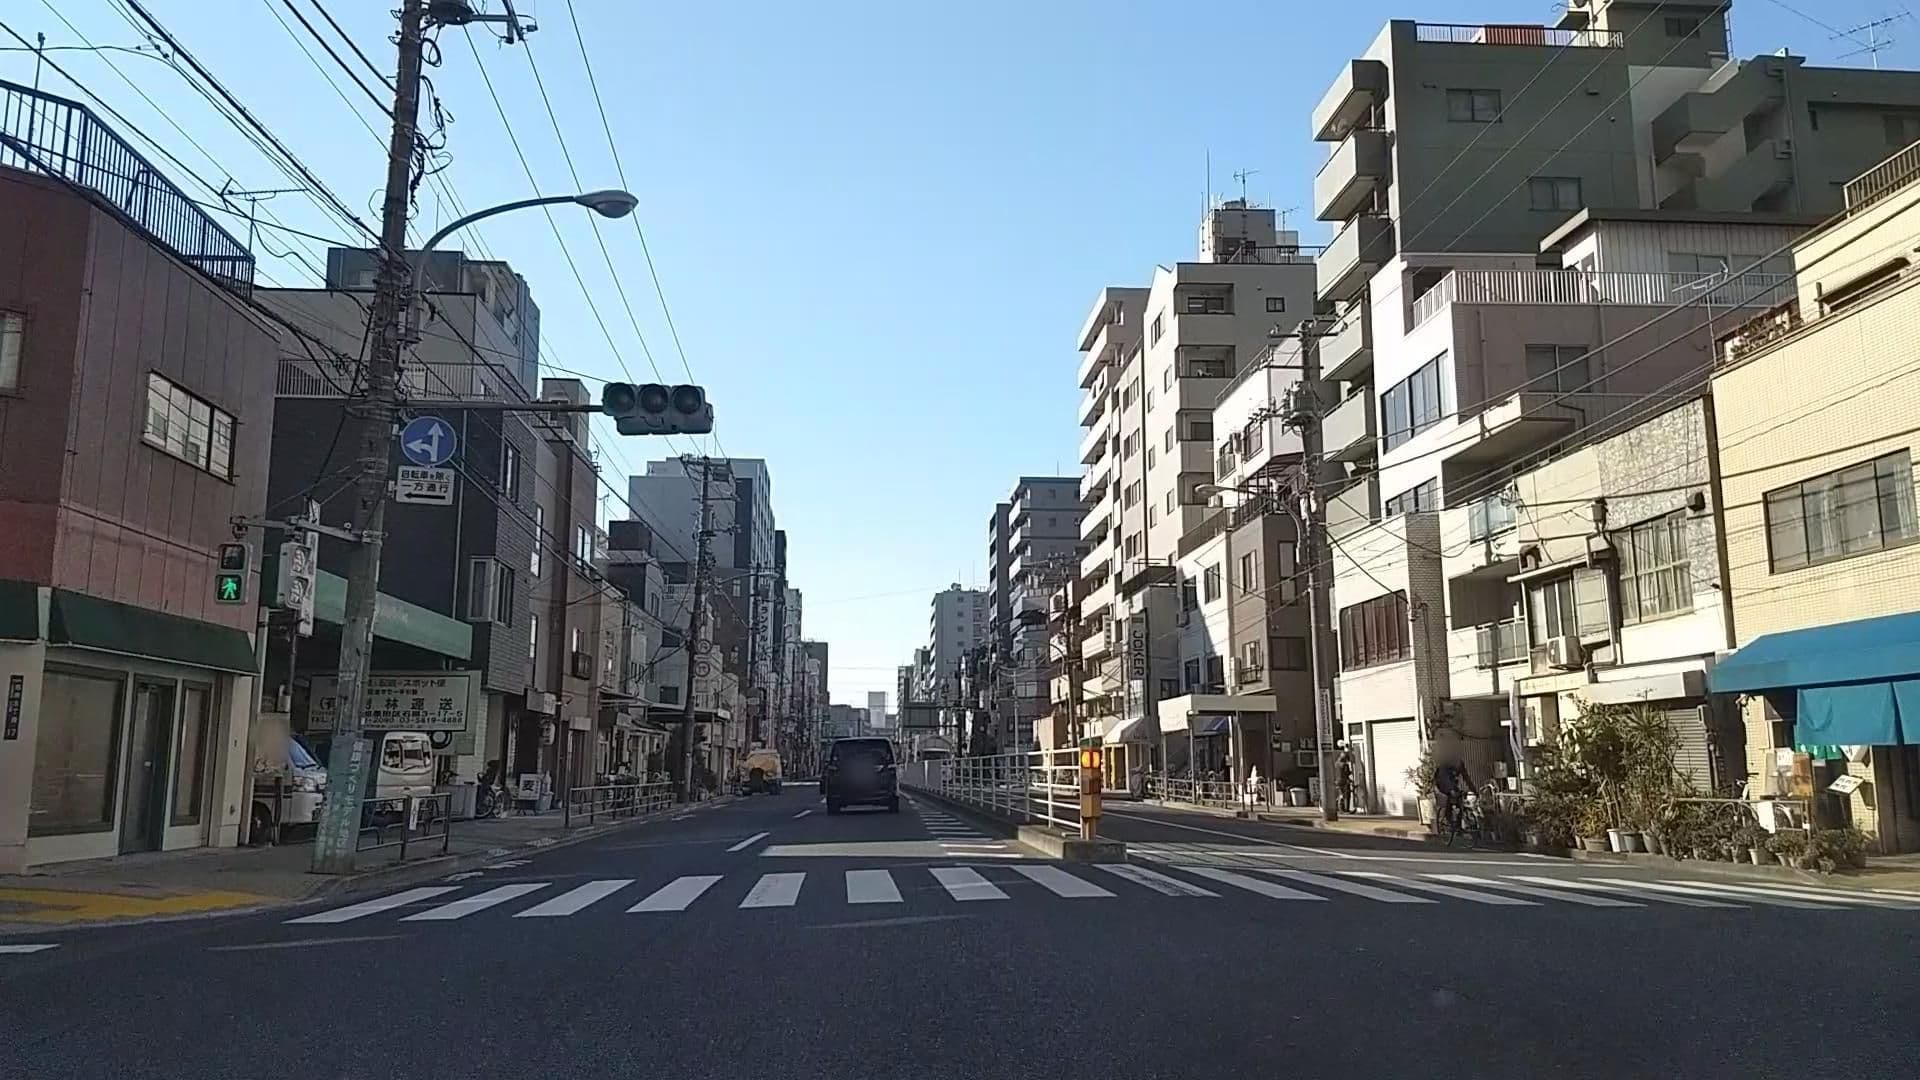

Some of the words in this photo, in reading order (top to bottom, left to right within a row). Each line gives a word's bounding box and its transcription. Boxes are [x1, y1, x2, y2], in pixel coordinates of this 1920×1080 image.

[401, 482, 449, 494] 一方通行
[1132, 629, 1145, 677] JOKER
